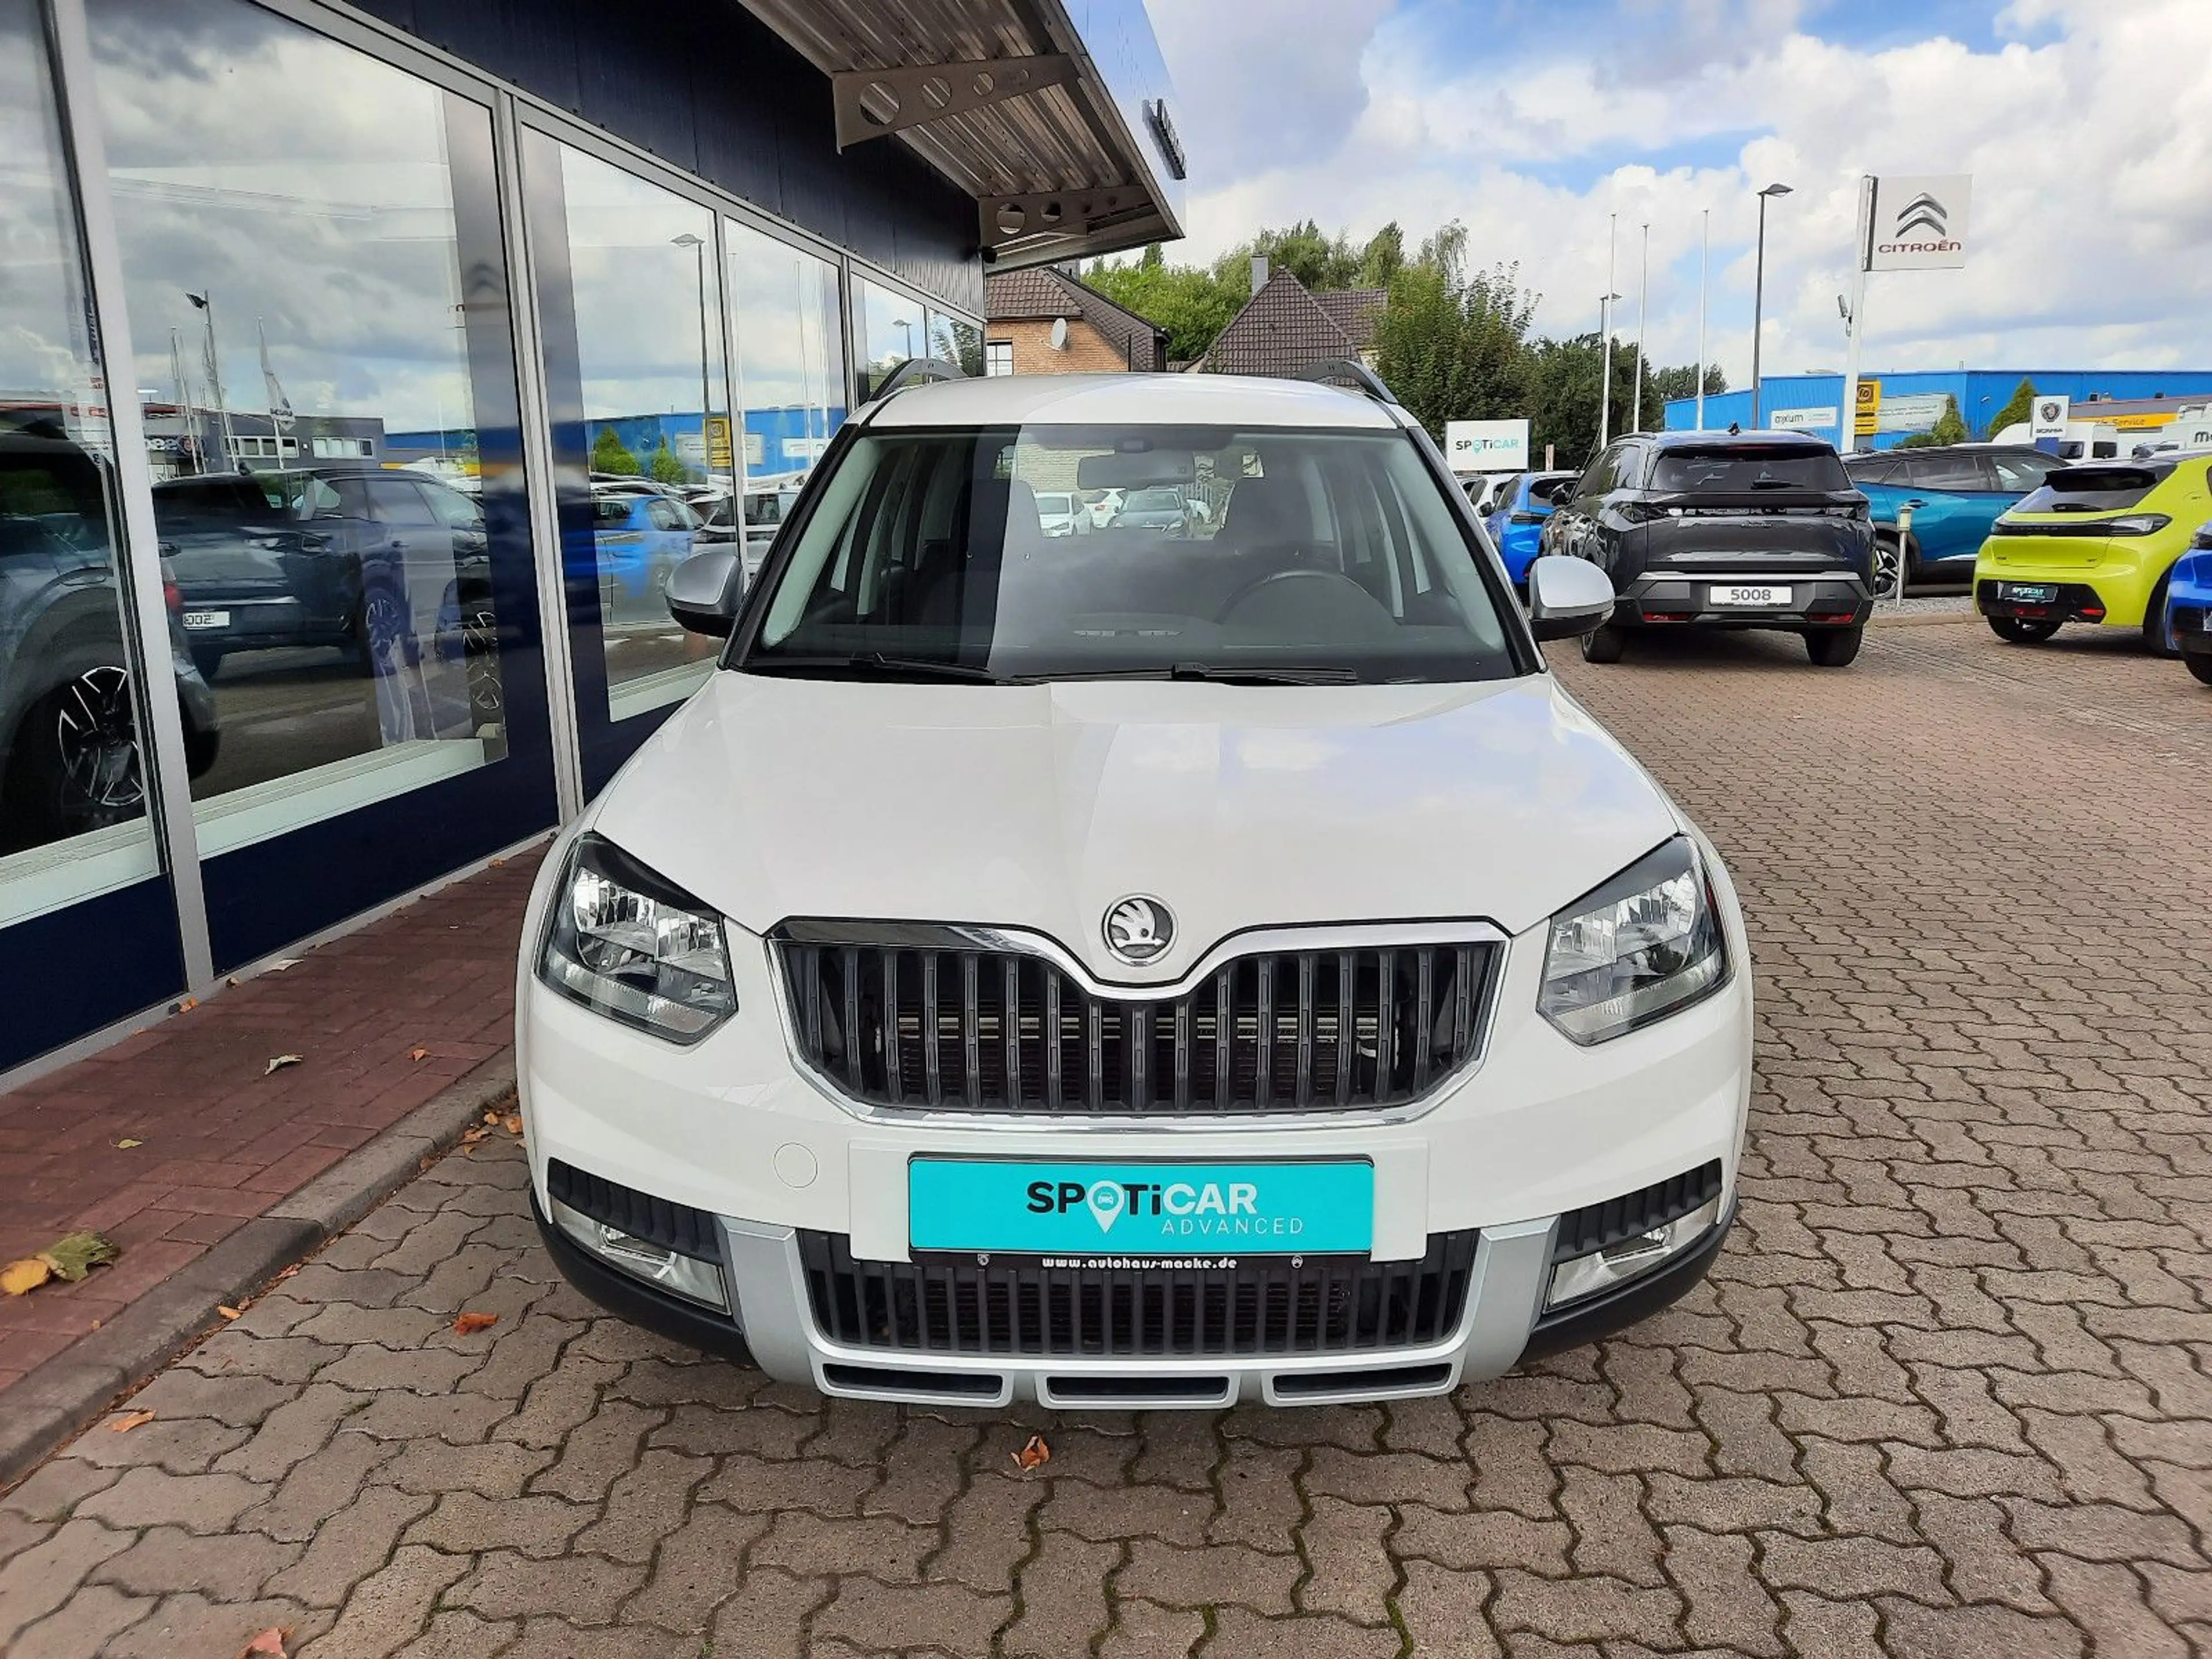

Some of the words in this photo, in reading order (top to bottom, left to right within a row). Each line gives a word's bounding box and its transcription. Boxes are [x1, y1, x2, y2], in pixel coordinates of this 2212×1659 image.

[1456, 438, 1519, 453] SPOTiCAR
[1730, 589, 1772, 601] 5008
[1027, 1181, 1257, 1234] SPOTiCAR
[1161, 1217, 1304, 1234] ADVANCED
